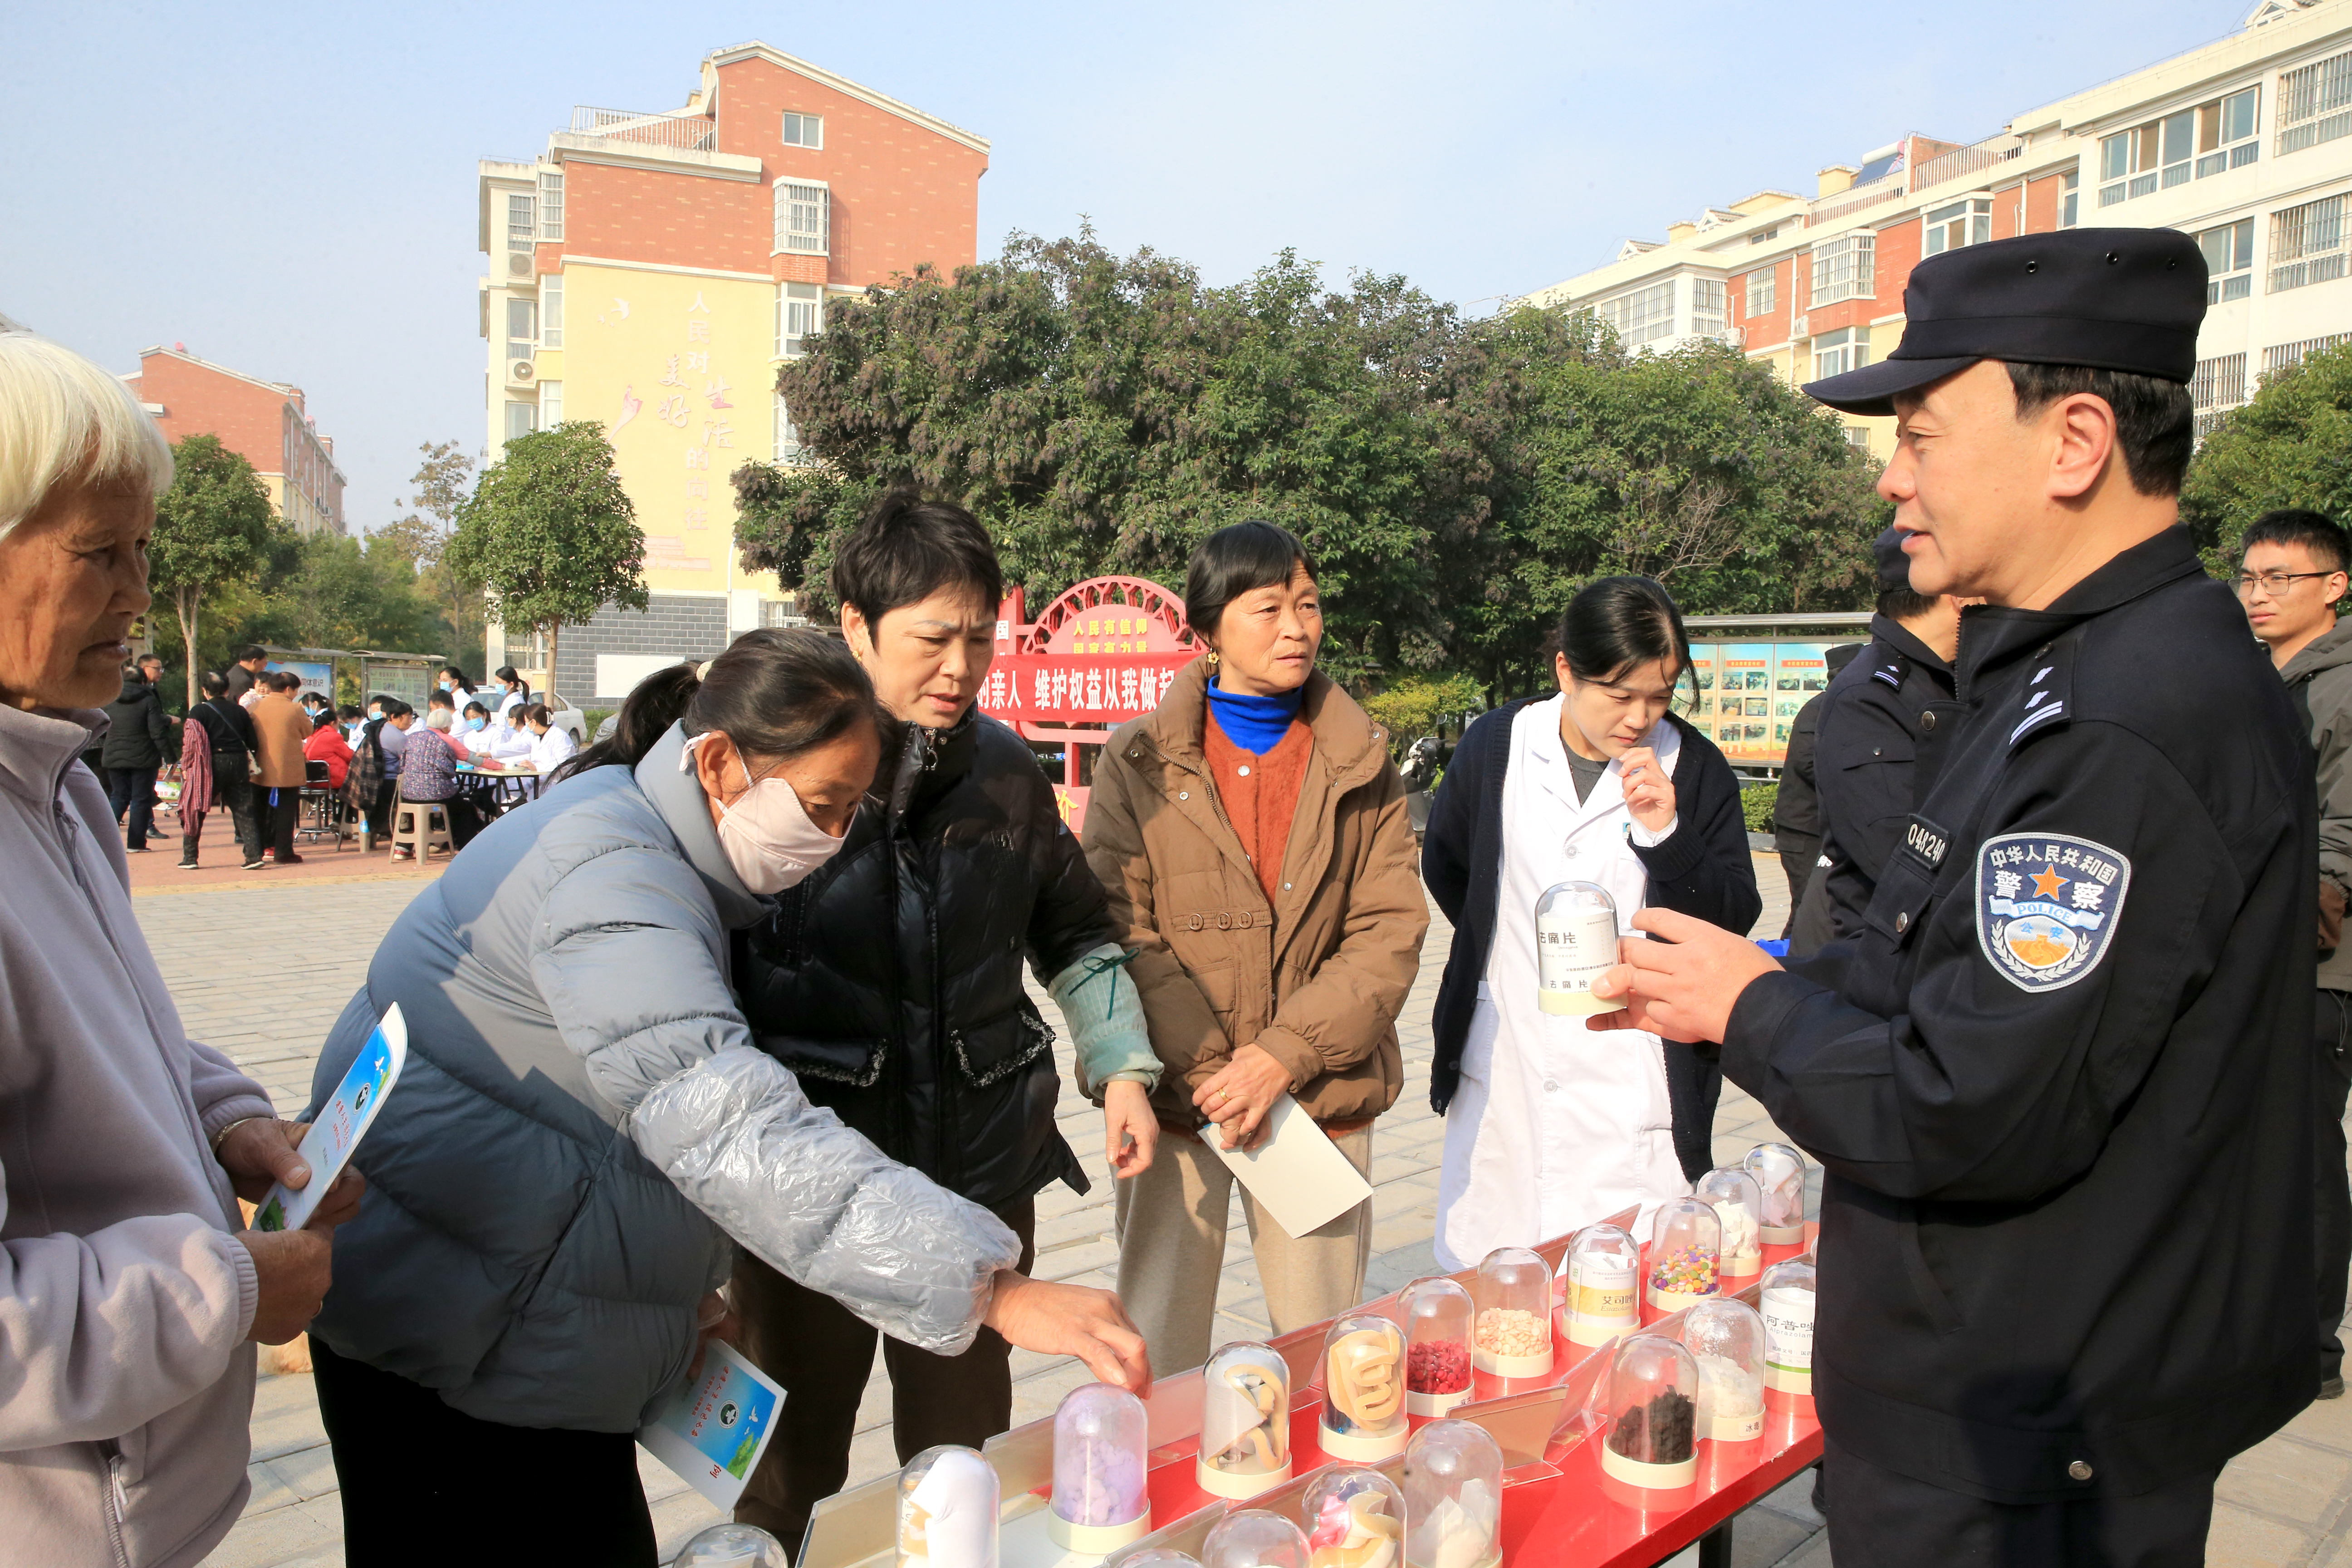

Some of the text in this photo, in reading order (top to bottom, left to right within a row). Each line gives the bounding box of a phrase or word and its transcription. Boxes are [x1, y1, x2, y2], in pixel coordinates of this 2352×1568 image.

[1073, 618, 1148, 636] 人民有信仰
[1907, 823, 1945, 863] 048240
[1989, 844, 2118, 886] 中华人民共和国
[1994, 870, 2105, 911] 警 察
[2017, 904, 2073, 922] POLICE
[1539, 931, 1576, 944] 去痛片
[1550, 980, 1588, 989] 去痛片
[1769, 1327, 1813, 1338] Alprazolam
[1745, 1421, 1759, 1432] 冰毒
[710, 1464, 721, 1479] 例
